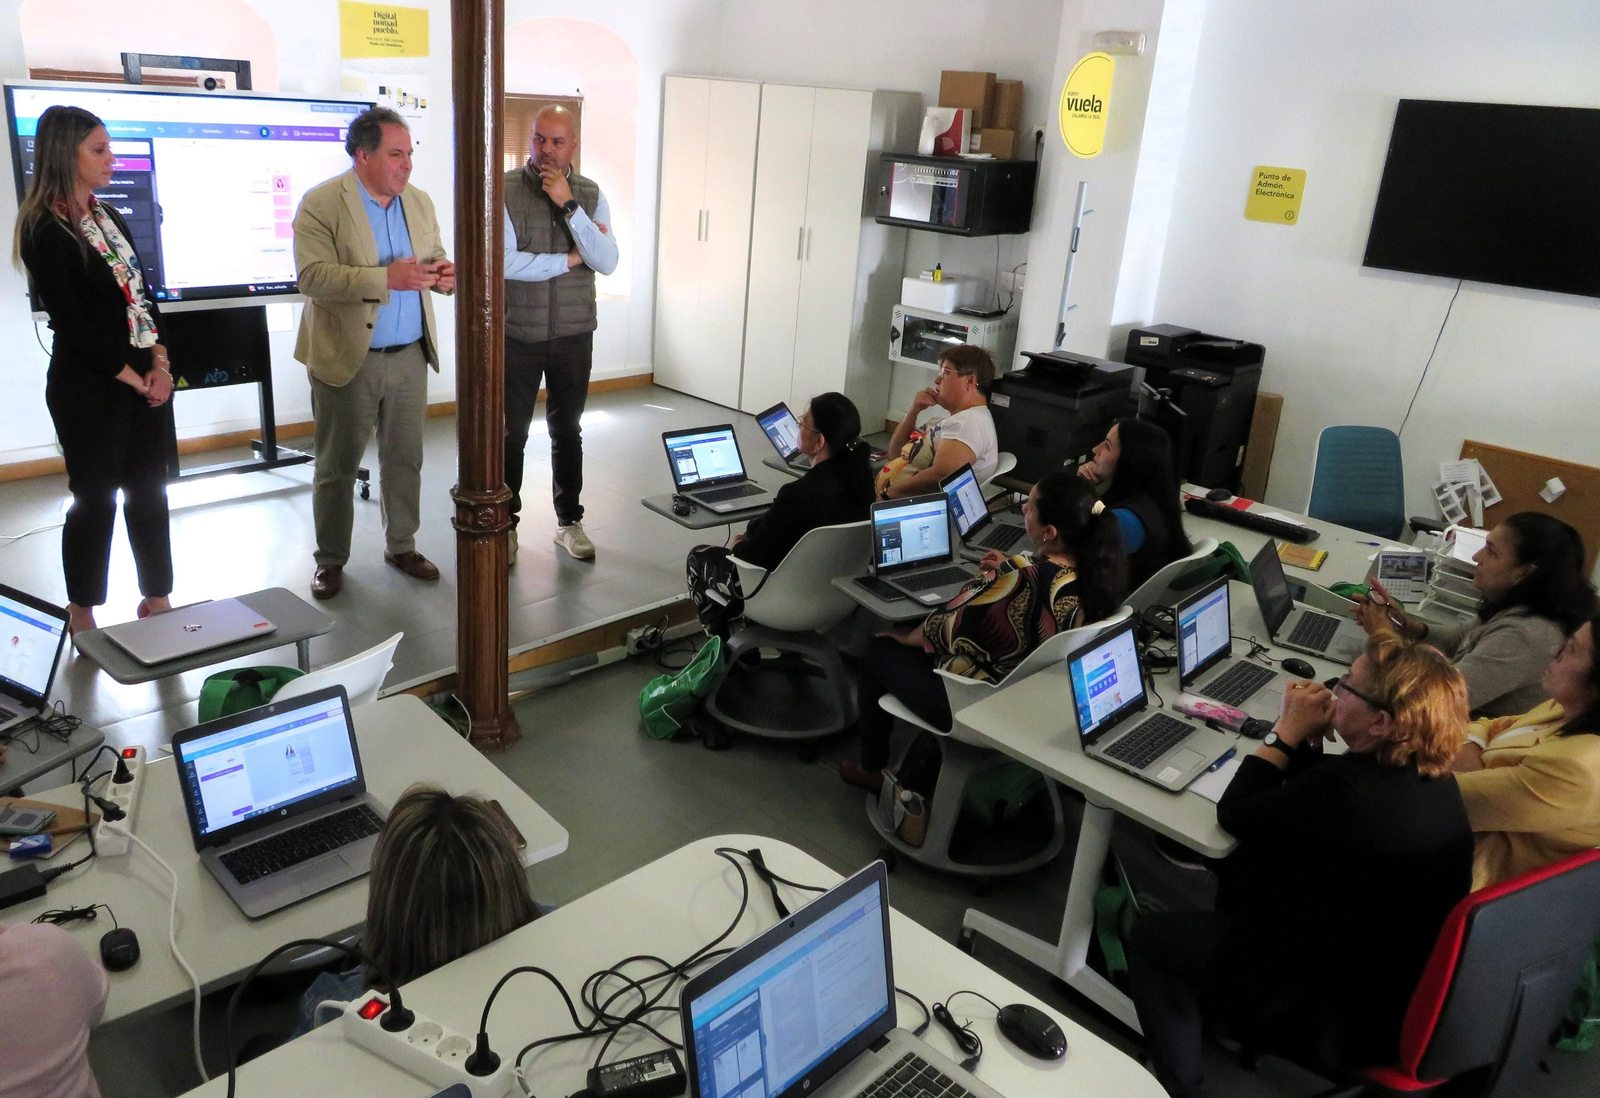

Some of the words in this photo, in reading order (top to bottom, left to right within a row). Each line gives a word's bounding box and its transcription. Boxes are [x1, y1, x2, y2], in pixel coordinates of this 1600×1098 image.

[373, 11, 397, 20] Digital
[373, 19, 398, 27] nomad
[1067, 94, 1103, 113] vuela
[1259, 172, 1280, 180] Punto
